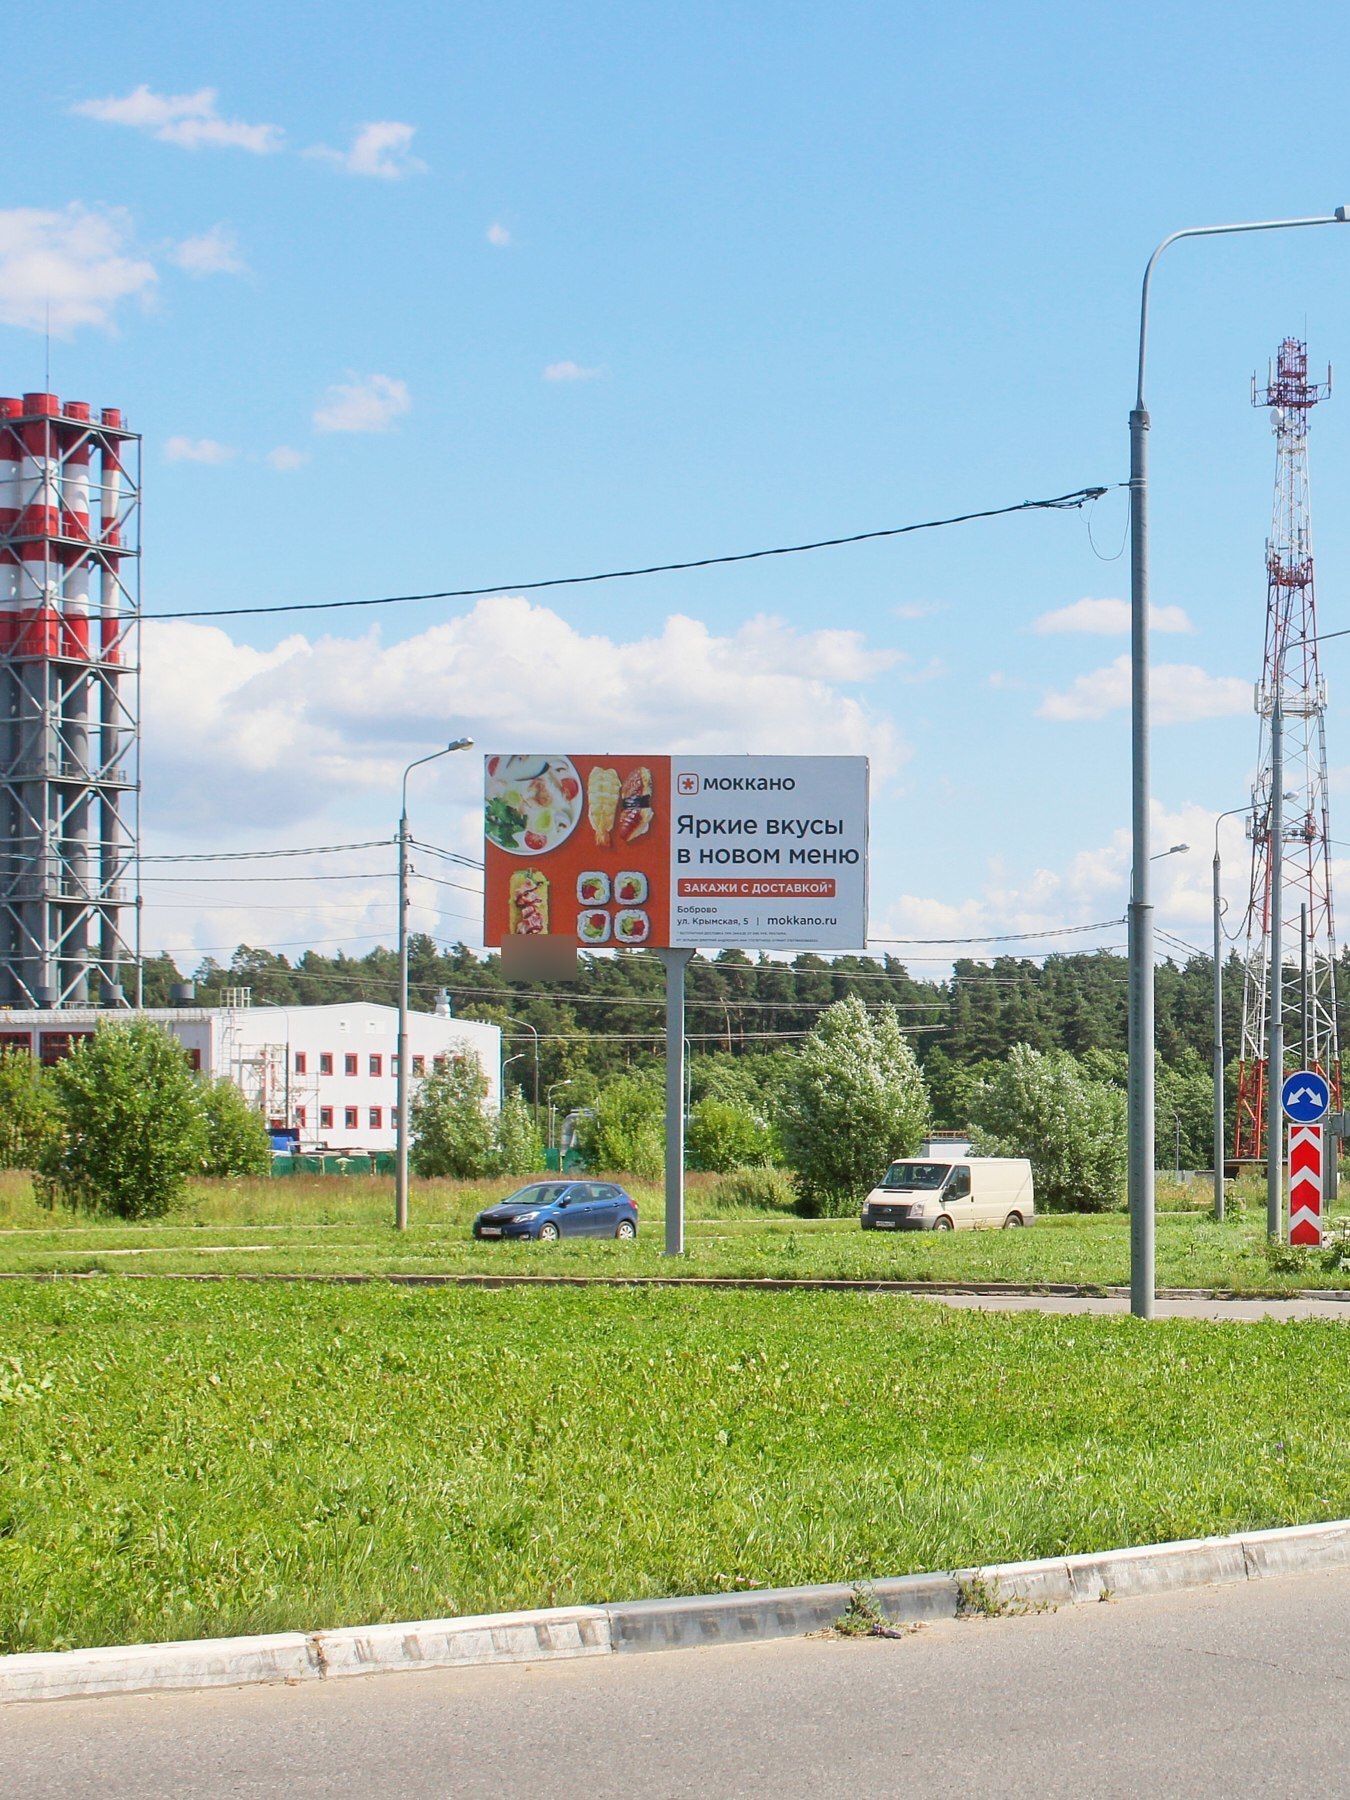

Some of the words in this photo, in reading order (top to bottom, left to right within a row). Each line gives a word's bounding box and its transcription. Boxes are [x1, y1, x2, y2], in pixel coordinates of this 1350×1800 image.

[677, 815, 758, 838] Яркие
[766, 818, 844, 838] вкусы
[677, 848, 691, 864] в
[700, 848, 780, 864] новом
[789, 848, 860, 864] меню
[684, 883, 738, 893] ЗАКАЖИ
[741, 883, 749, 893] С
[677, 905, 718, 915] Боброво
[677, 918, 690, 926] ул.
[692, 917, 741, 927] Крымская,
[743, 917, 749, 926] 5
[767, 915, 838, 926] mokkano.ru
